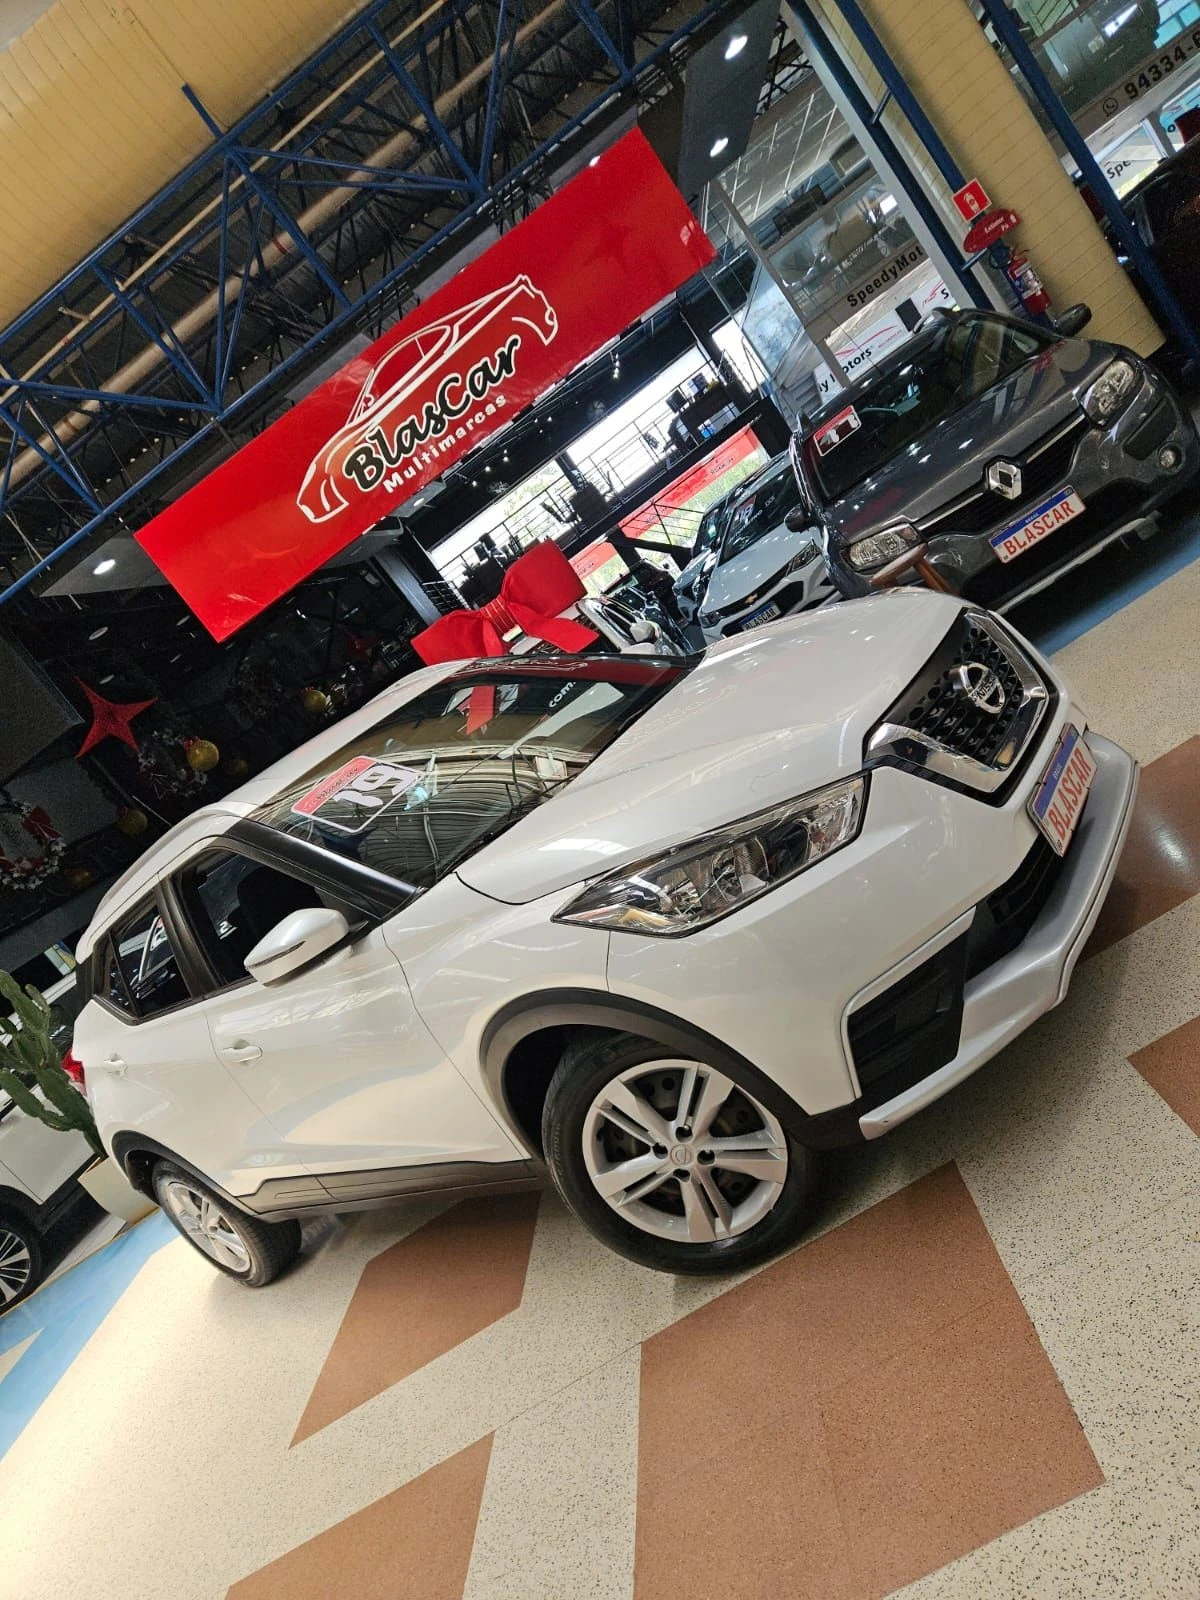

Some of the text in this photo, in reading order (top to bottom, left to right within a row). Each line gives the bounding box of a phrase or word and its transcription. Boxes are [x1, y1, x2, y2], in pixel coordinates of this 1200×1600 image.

[343, 335, 521, 491] BlasCar
[382, 394, 507, 494] Multimarcas
[1003, 500, 1075, 556] BLASCAR
[1048, 747, 1092, 841] BLASCAR
